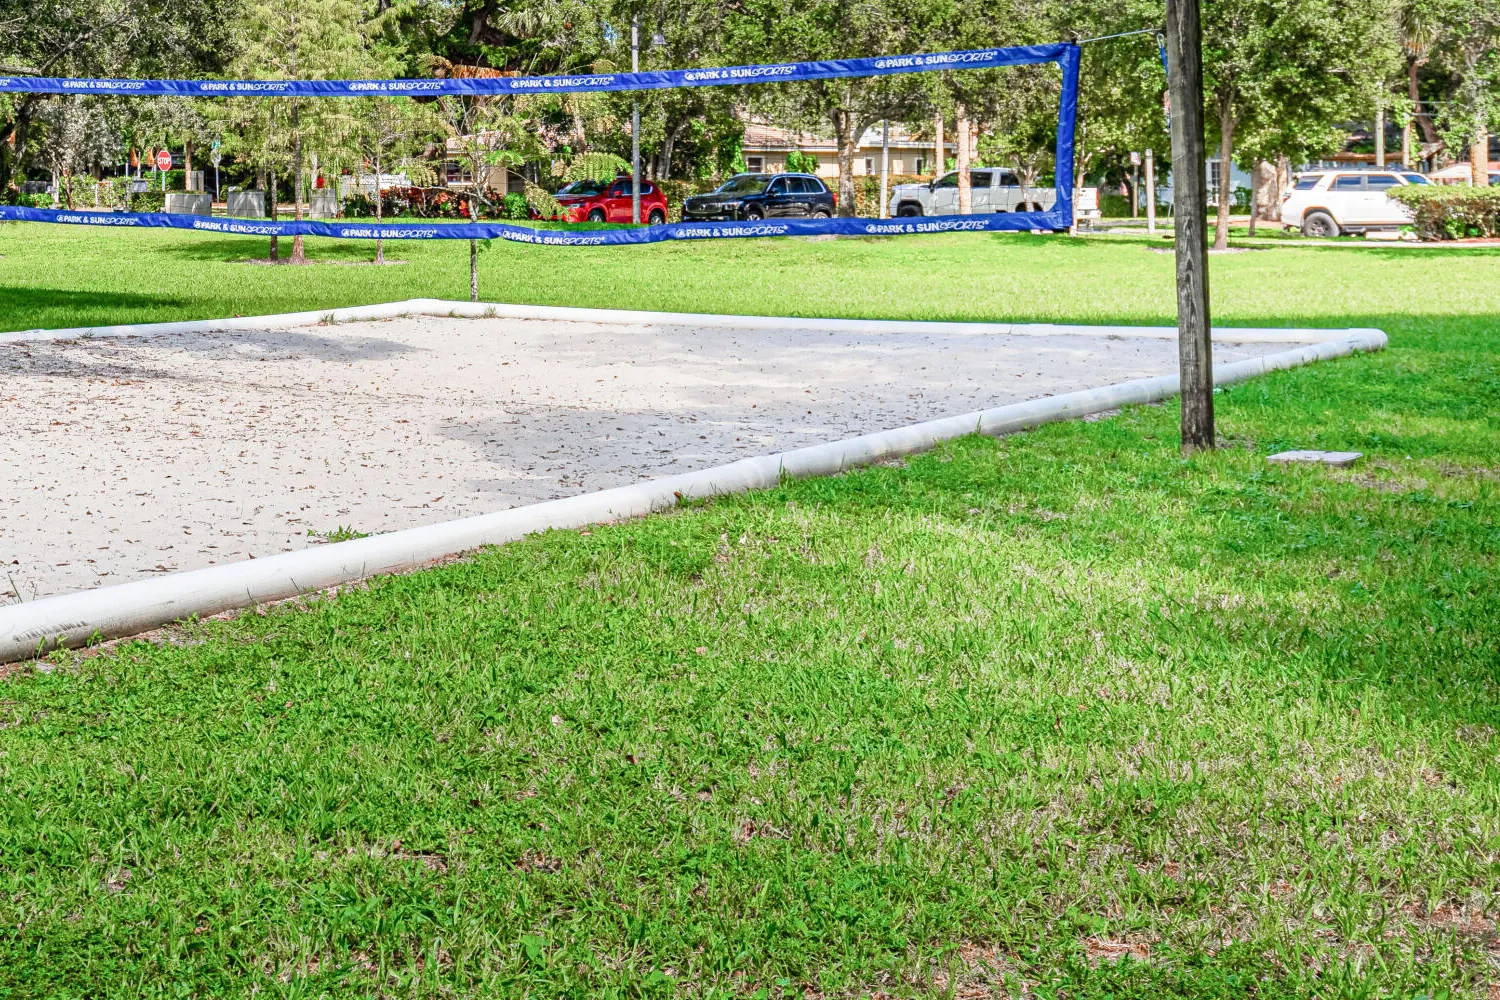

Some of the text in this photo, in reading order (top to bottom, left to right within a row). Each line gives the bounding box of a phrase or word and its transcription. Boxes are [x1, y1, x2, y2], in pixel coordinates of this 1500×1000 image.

[886, 58, 914, 67] PARK
[695, 71, 720, 80] PARK
[520, 80, 543, 88] PARK
[158, 157, 170, 165] STOP
[351, 229, 372, 237] PARK
[686, 228, 711, 237] PARK
[877, 224, 905, 233] PARK
[511, 232, 533, 242] PARK
